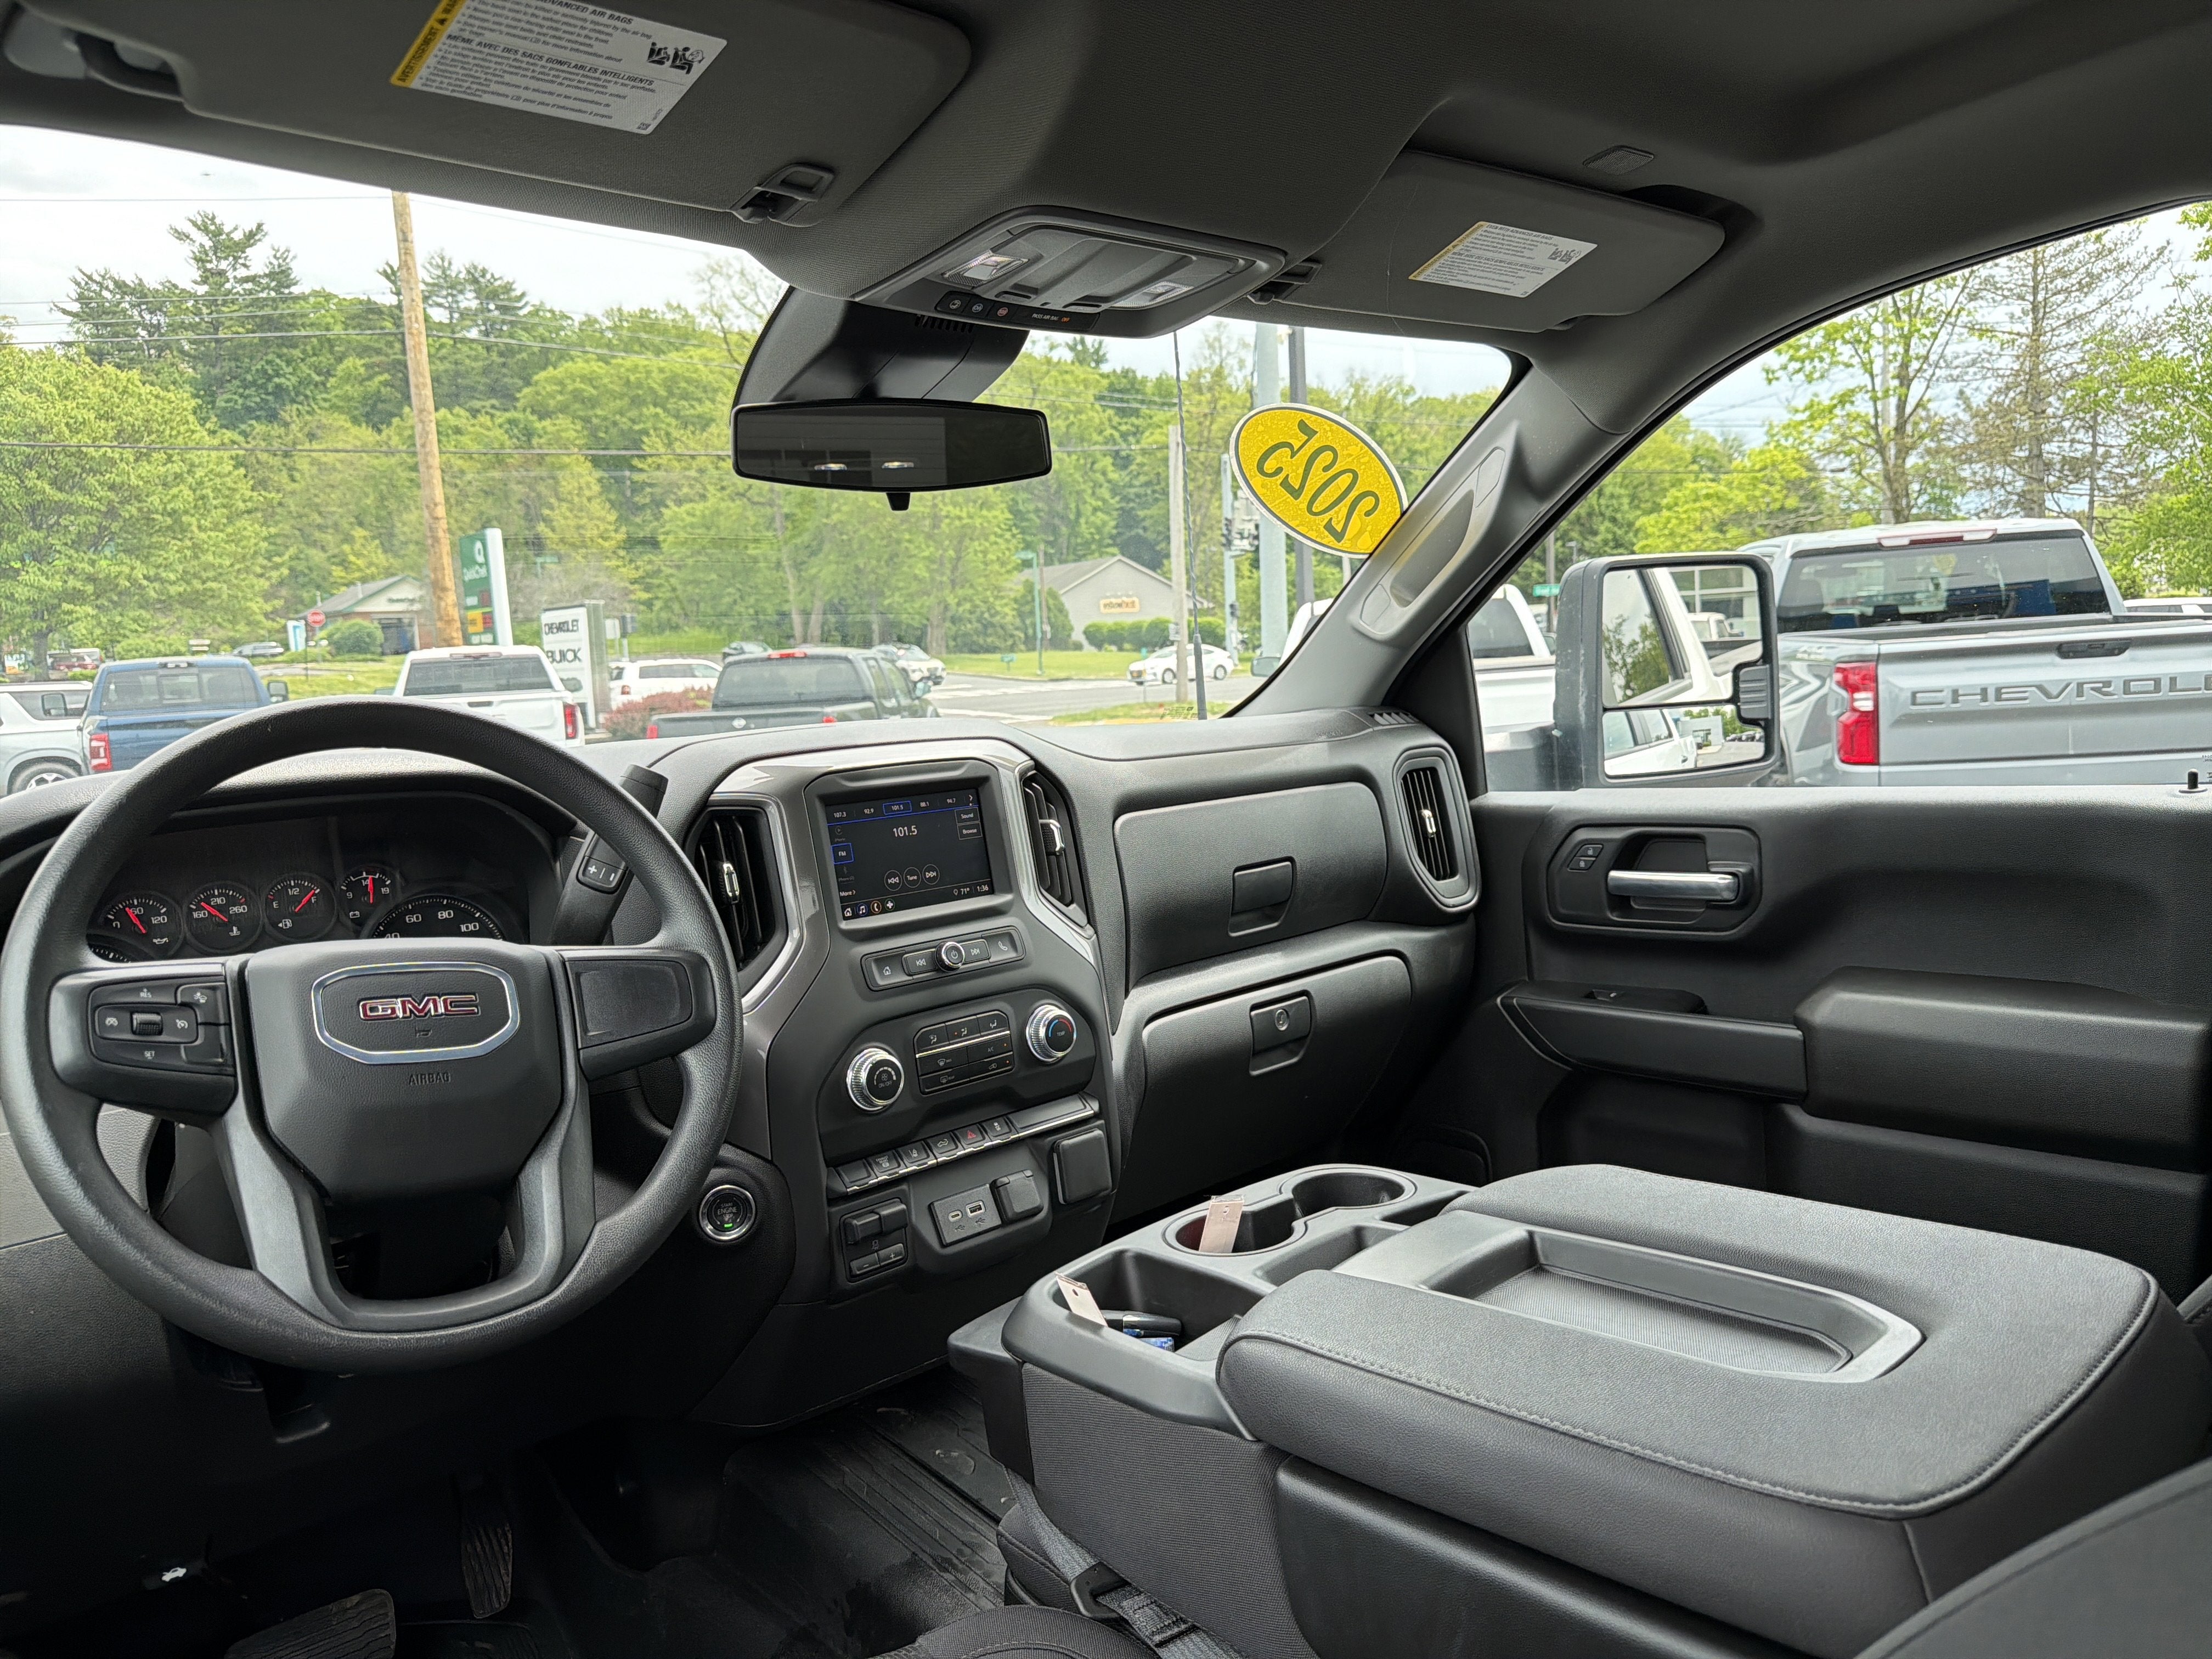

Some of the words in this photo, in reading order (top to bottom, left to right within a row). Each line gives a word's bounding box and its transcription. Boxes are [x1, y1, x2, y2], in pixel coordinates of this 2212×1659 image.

[590, 9, 607, 18] AIR
[607, 13, 634, 25] BAGS
[588, 19, 613, 29] injured
[588, 27, 616, 38] children.
[551, 42, 570, 50] more
[568, 46, 605, 59] information
[603, 54, 624, 63] about
[476, 41, 501, 51] AVEC
[501, 47, 521, 55] DES
[520, 51, 546, 61] SACS
[545, 57, 600, 74] GONFLABLES
[599, 69, 655, 86] INTELLIGENTS
[565, 82, 595, 93] protection
[547, 647, 582, 664] BUICK
[893, 825, 917, 837] 101.5
[287, 887, 300, 895] 1/2
[211, 896, 225, 906] 210
[311, 896, 317, 904] F
[193, 910, 208, 919] 160
[229, 905, 247, 914] 260
[151, 916, 168, 924] 120
[406, 913, 422, 924] 60
[438, 910, 454, 920] 80
[460, 922, 479, 932] 100
[359, 995, 479, 1021] GMC
[408, 1071, 451, 1086] AIRBAG
[878, 1080, 893, 1088] ON/OFF
[718, 1206, 737, 1215] ENGINE
